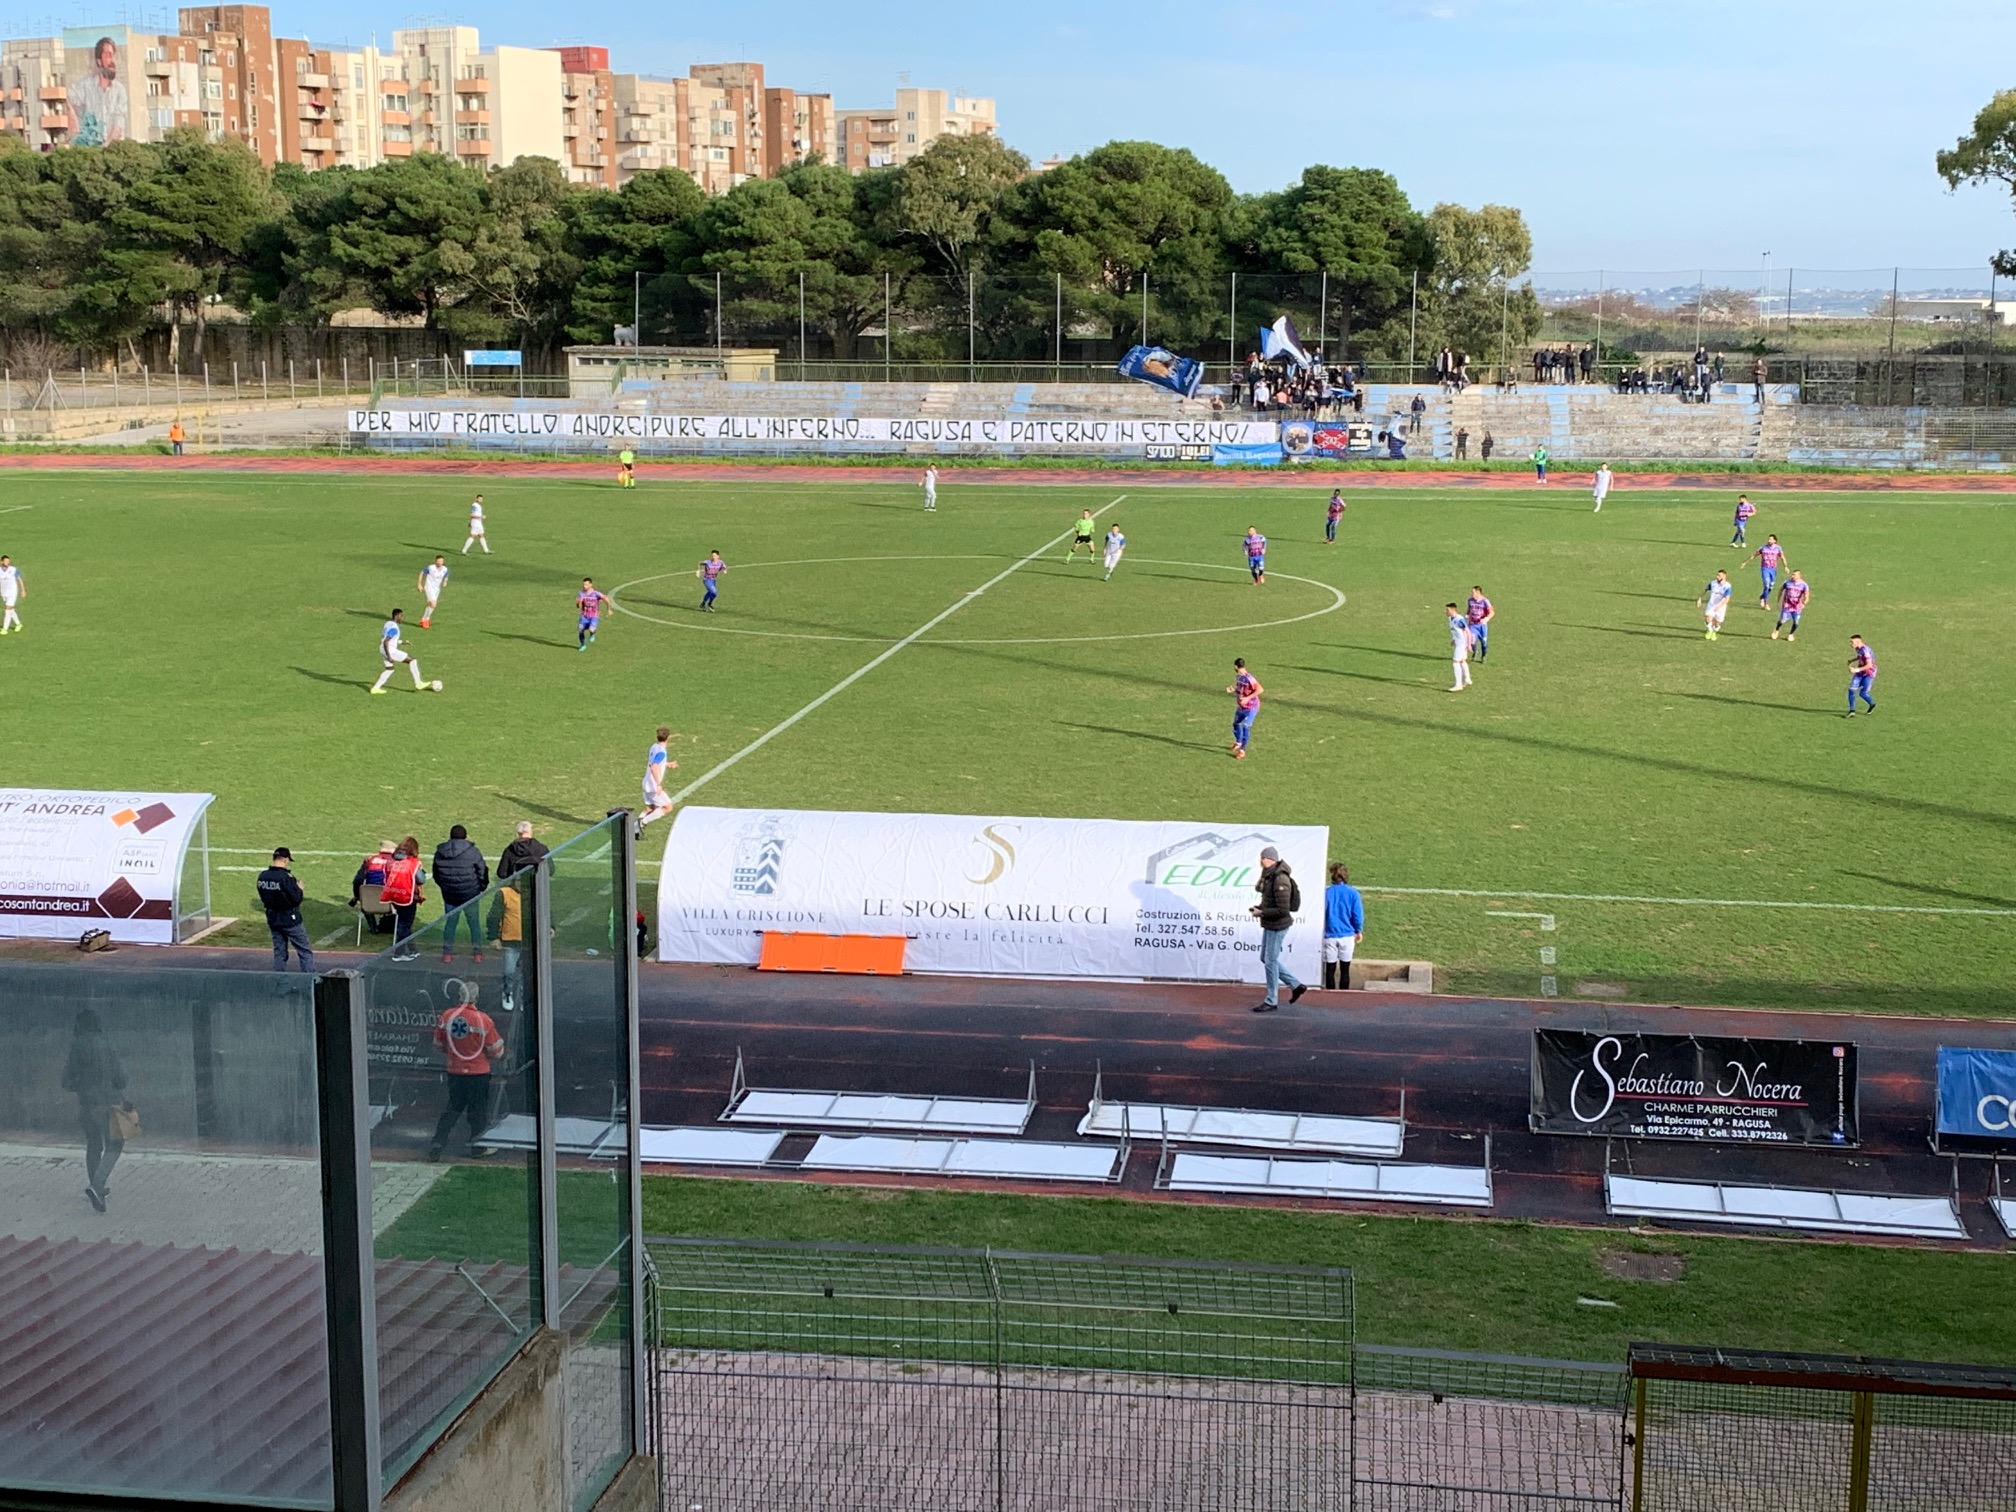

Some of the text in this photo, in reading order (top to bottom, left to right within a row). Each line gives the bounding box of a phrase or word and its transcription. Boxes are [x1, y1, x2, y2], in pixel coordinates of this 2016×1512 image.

[356, 411, 391, 431] PER
[409, 412, 441, 431] MIO
[453, 413, 558, 434] FRATELLO
[890, 420, 971, 441] RAGUSA
[982, 421, 997, 441] E
[1141, 422, 1250, 443] ETERNO!
[38, 794, 141, 805] ORTOPEDICO
[22, 803, 106, 816] ANDREA
[683, 908, 827, 923] VILLA CRISCIONE
[863, 898, 1109, 925] LE SPOSE CARLUCCI
[1135, 908, 1201, 921] Costruzioni
[1205, 911, 1213, 921] &
[705, 928, 750, 937] LUXURY
[964, 928, 979, 942] la
[1136, 923, 1235, 936] Tel. 327.547.58.56
[1134, 938, 1187, 951] RAGUSA
[1196, 940, 1215, 951] Via
[1217, 941, 1230, 952] G.
[1570, 1037, 1802, 1123] Sebastiano Nocera
[1643, 1102, 1779, 1117] CHARME PARRUCCHIERI
[1646, 1114, 1663, 1124] Via
[1712, 1117, 1724, 1127] 49
[1732, 1118, 1772, 1129] RAGUSA
